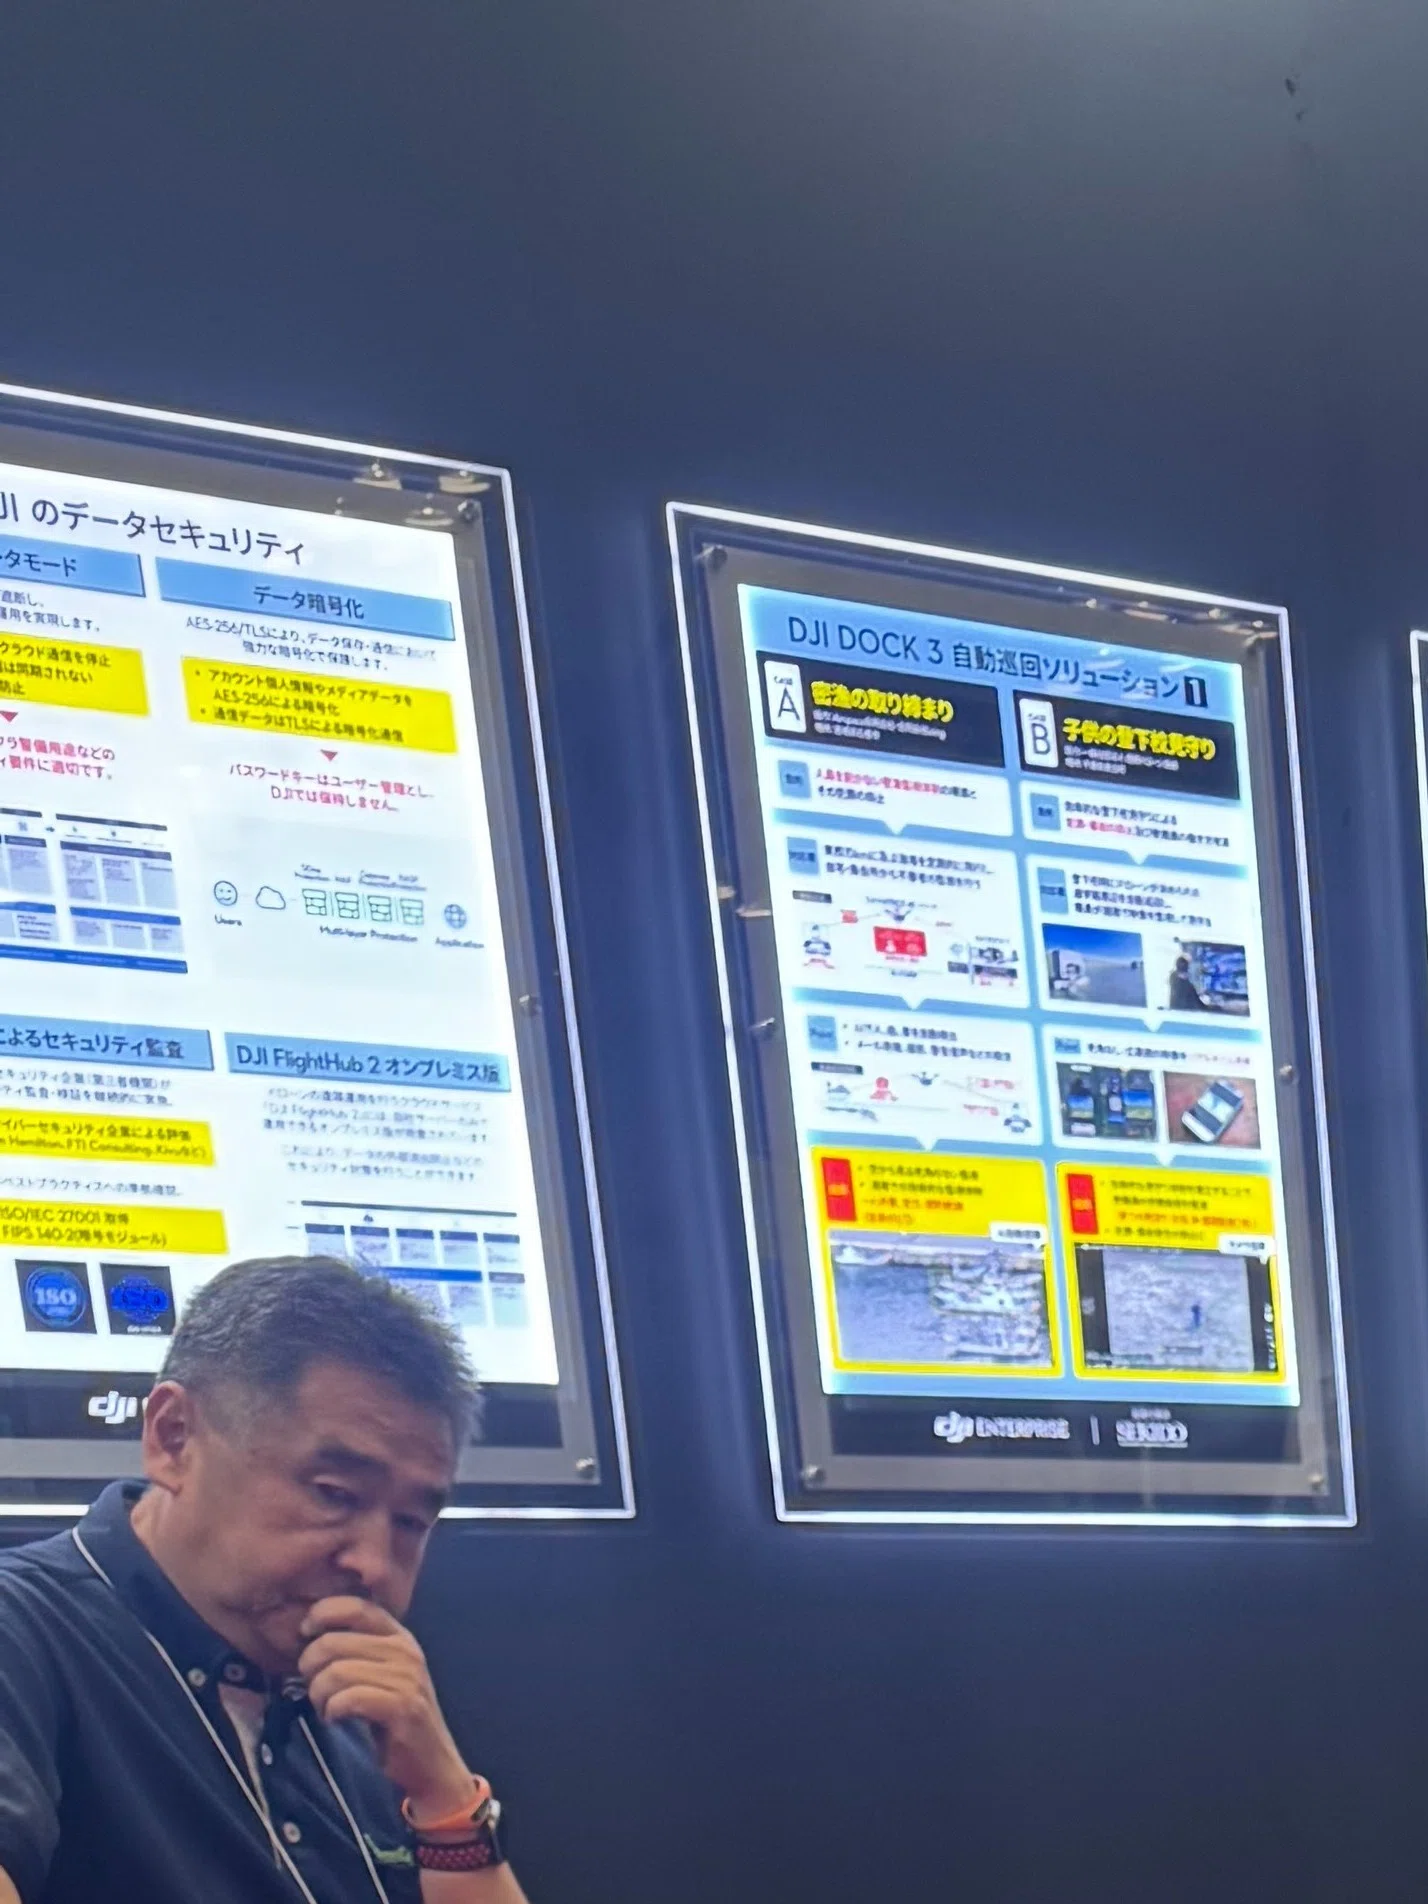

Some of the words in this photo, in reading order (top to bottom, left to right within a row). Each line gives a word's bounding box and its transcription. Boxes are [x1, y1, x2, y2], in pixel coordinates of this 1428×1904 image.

[32, 499, 304, 565] のデータセキュリティ
[0, 549, 76, 577] タモード
[254, 586, 365, 620] データ暗号化
[788, 616, 828, 648] DJI
[838, 625, 920, 662] DOCK
[927, 638, 943, 664] 3
[953, 643, 1179, 698] 自動巡回ソリューション
[778, 687, 800, 720] A
[1032, 723, 1050, 755] B
[236, 1044, 269, 1067] DJI
[273, 1047, 364, 1075] FlightHub
[368, 1055, 382, 1075] 2
